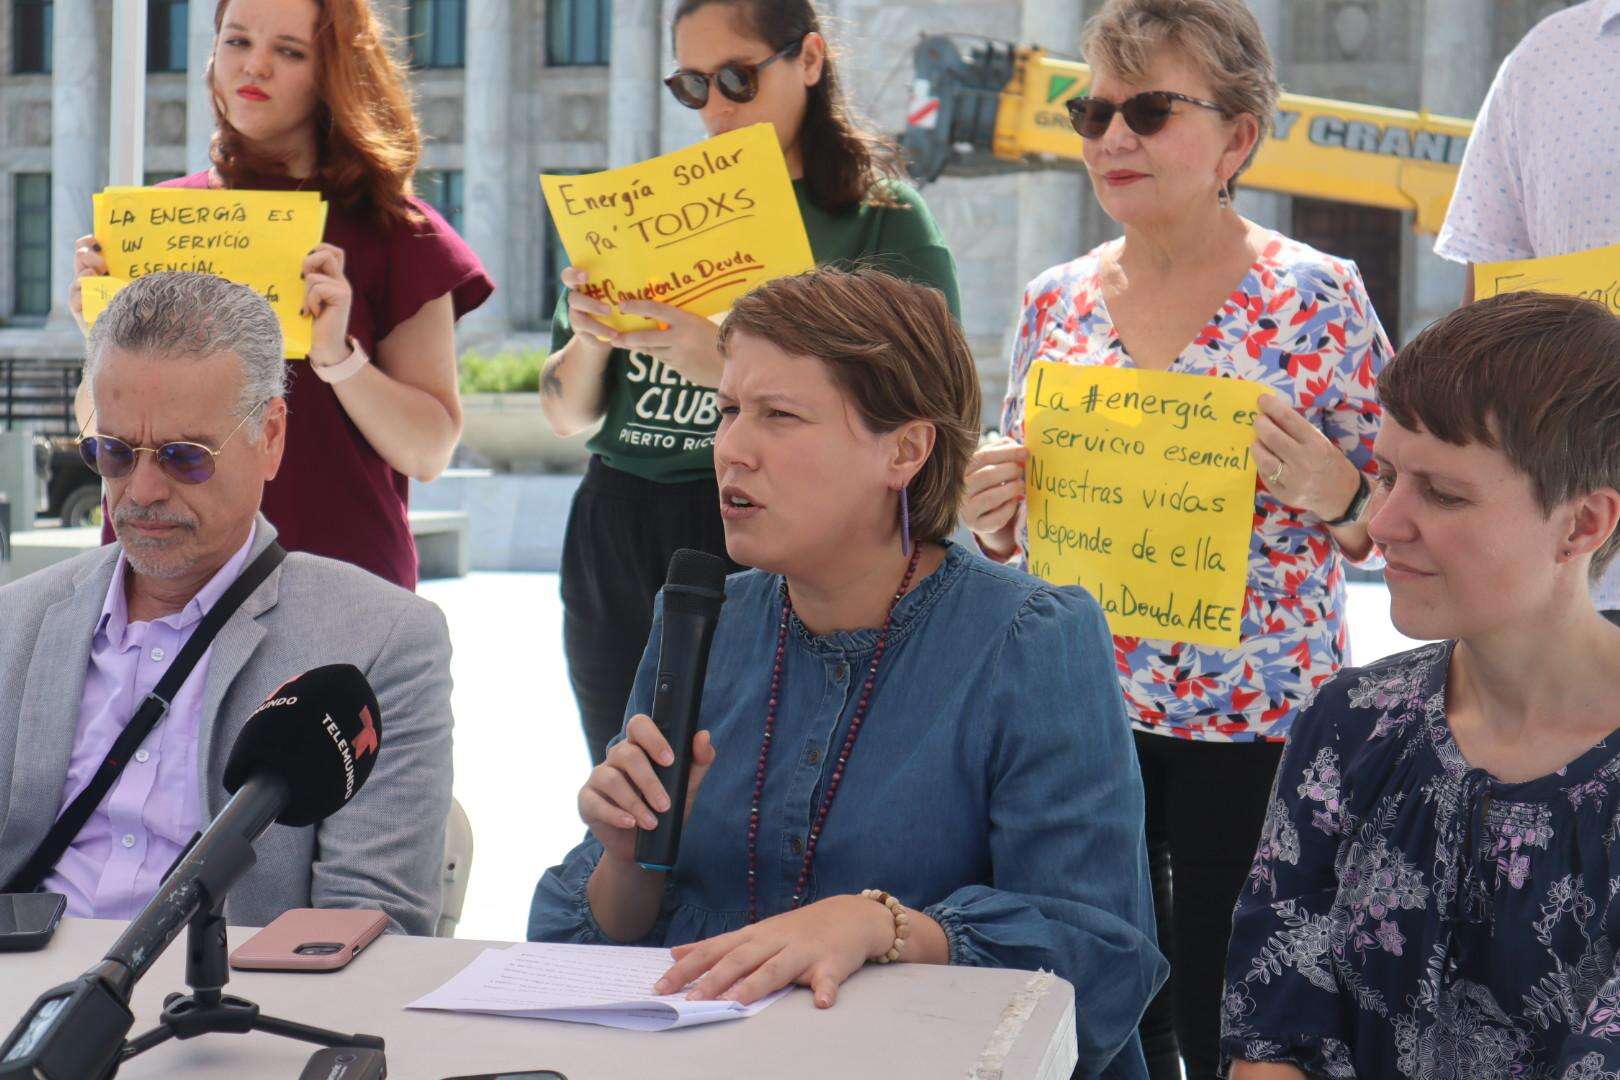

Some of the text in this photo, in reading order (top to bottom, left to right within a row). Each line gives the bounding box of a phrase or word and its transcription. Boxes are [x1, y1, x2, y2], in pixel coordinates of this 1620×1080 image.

[558, 148, 744, 217] Energía Solar
[109, 208, 136, 226] LA
[267, 209, 295, 222] ES
[121, 231, 250, 254] UN SERVICIO
[628, 188, 756, 243] TODXS
[635, 386, 718, 425] CLUB
[1034, 367, 1070, 412] La
[1232, 408, 1258, 427] es
[1041, 427, 1250, 471] servicio esencial
[1030, 455, 1227, 514] Nuestras vidas
[1036, 499, 1227, 572] depende de ella
[321, 713, 355, 800] TELEMUNDO
